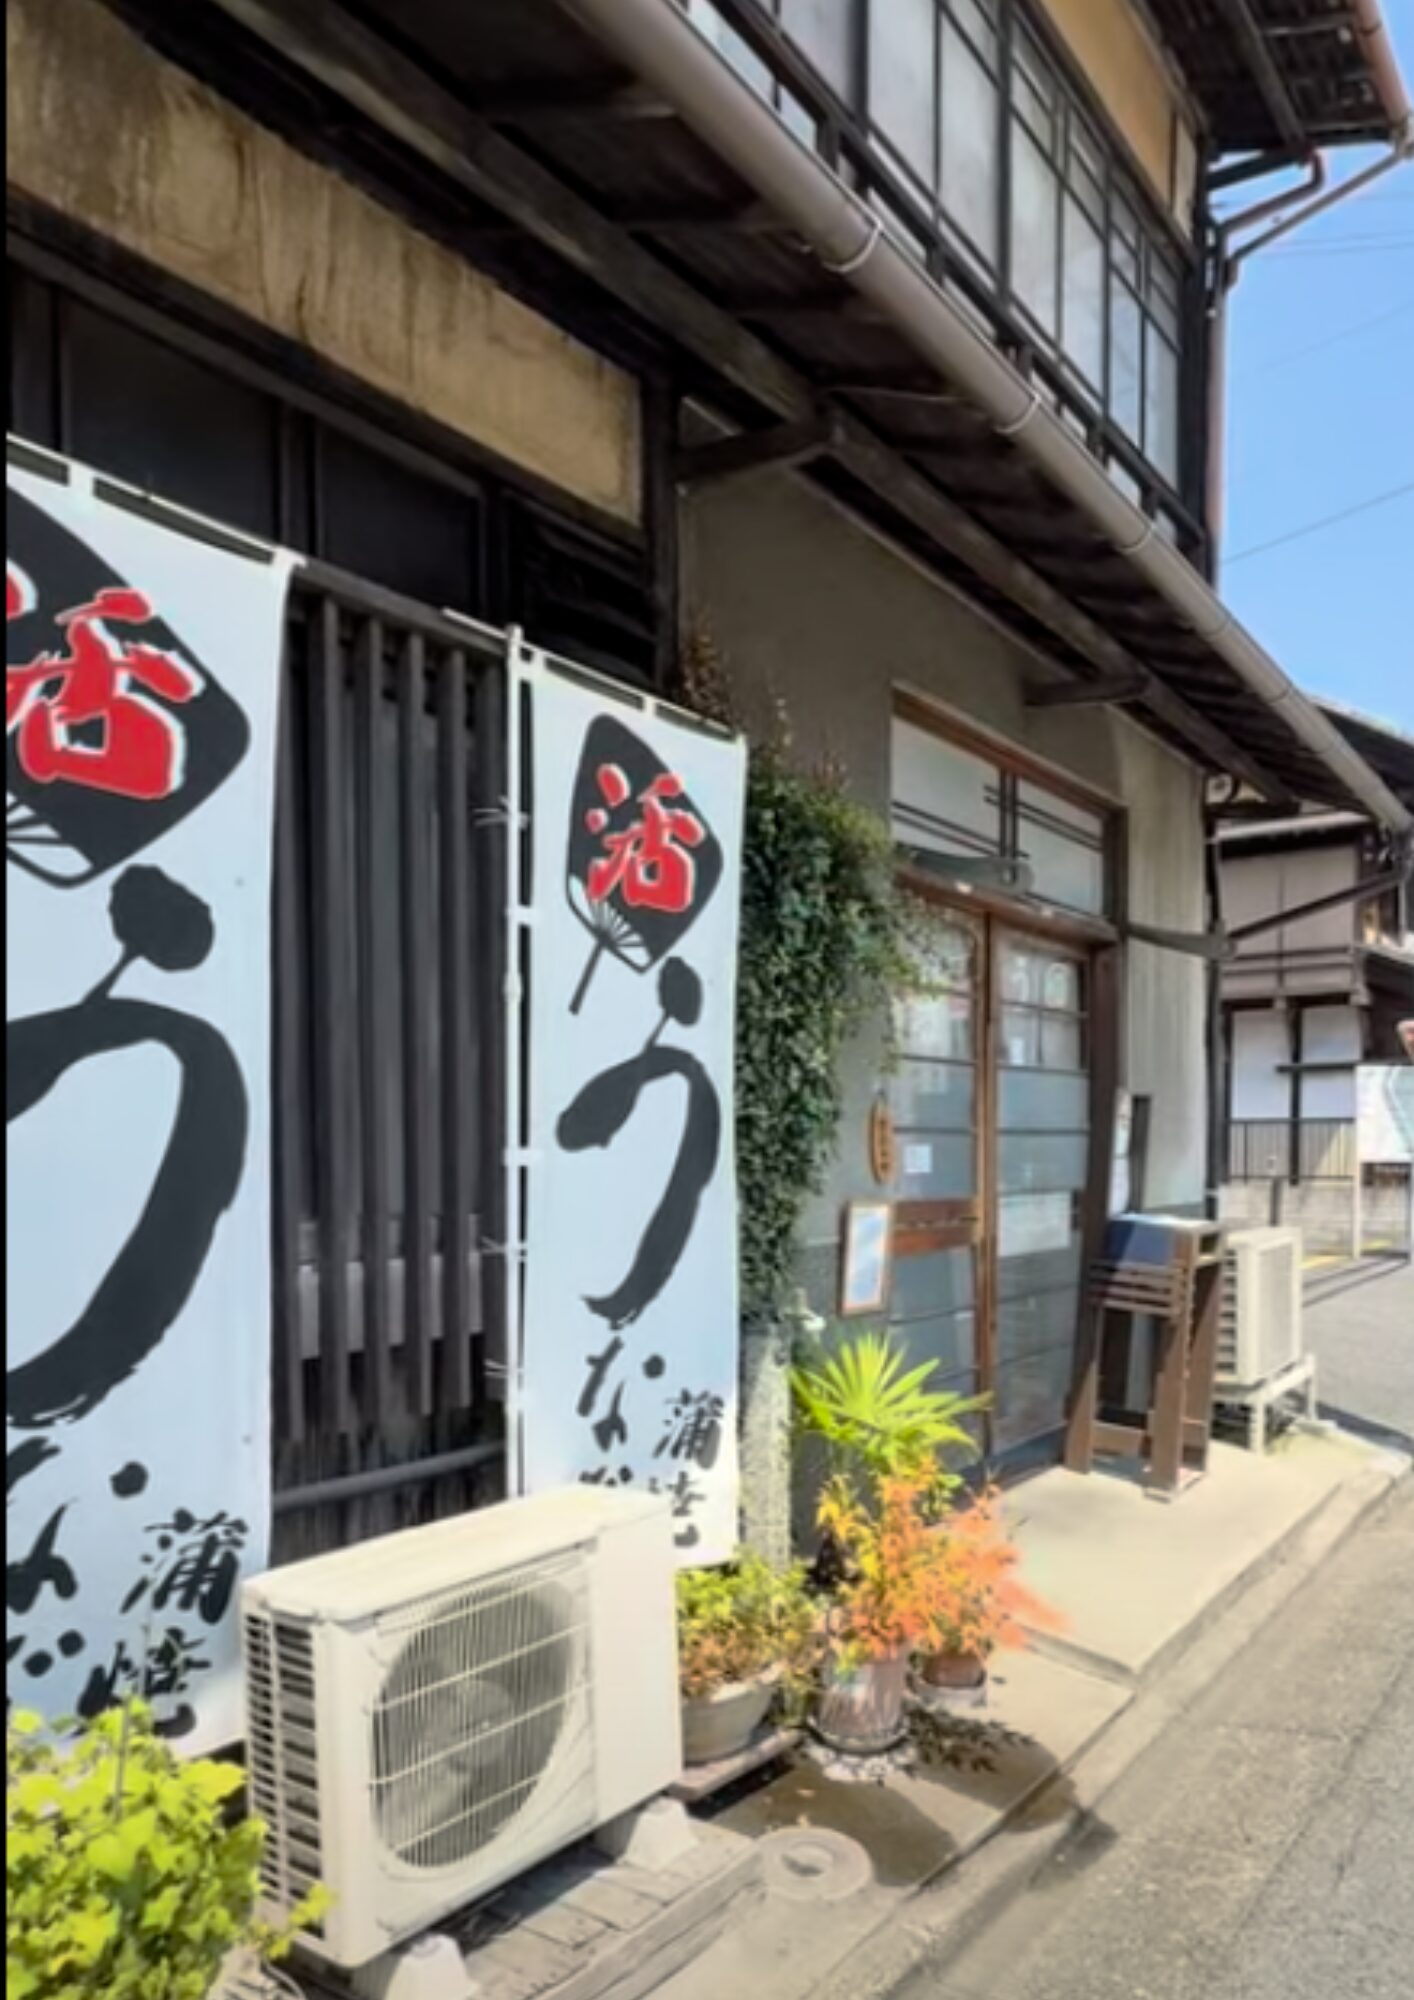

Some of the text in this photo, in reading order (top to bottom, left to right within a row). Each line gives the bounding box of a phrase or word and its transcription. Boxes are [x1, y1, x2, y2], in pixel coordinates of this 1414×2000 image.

[7, 572, 204, 799] 活
[584, 762, 706, 913] 活
[7, 864, 249, 1680] うな
[555, 956, 721, 1488] うな
